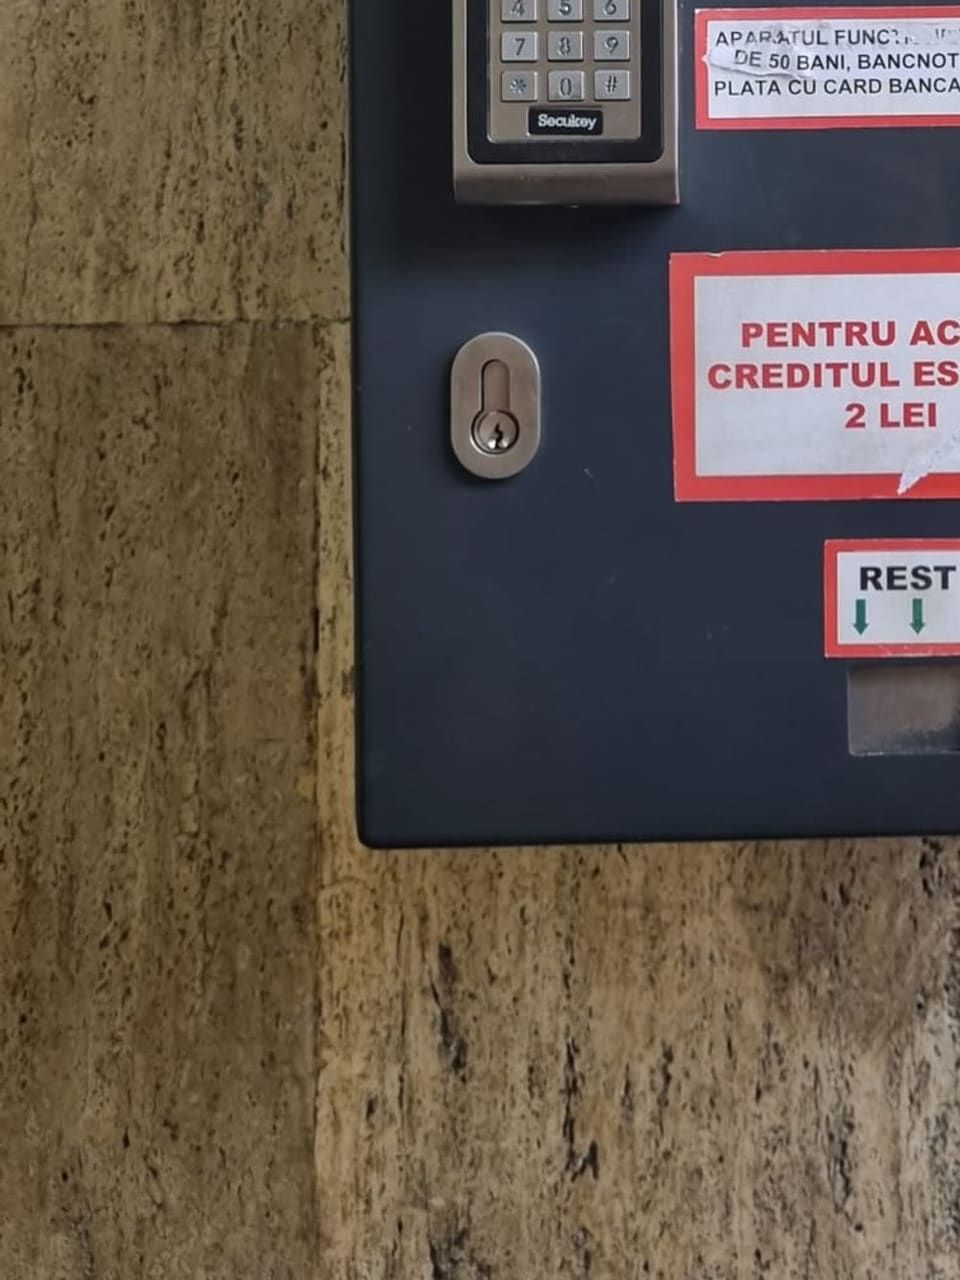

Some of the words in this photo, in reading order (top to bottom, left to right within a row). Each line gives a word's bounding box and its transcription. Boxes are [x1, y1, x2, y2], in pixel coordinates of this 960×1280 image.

[514, 38, 526, 57] 7
[558, 38, 570, 56] 8
[605, 37, 618, 55] 9
[716, 30, 828, 46] APARATUL
[735, 49, 762, 67] DE
[769, 54, 790, 70] 50
[797, 53, 850, 72] BANI,
[559, 77, 572, 97] 0
[715, 80, 781, 96] PLATA
[788, 79, 816, 95] CU
[824, 78, 882, 94] CARD
[741, 321, 896, 348] PENTRU
[707, 362, 900, 389] CREDITUL
[845, 403, 866, 429] 2
[881, 402, 937, 428] LEI
[859, 565, 957, 591] REST
